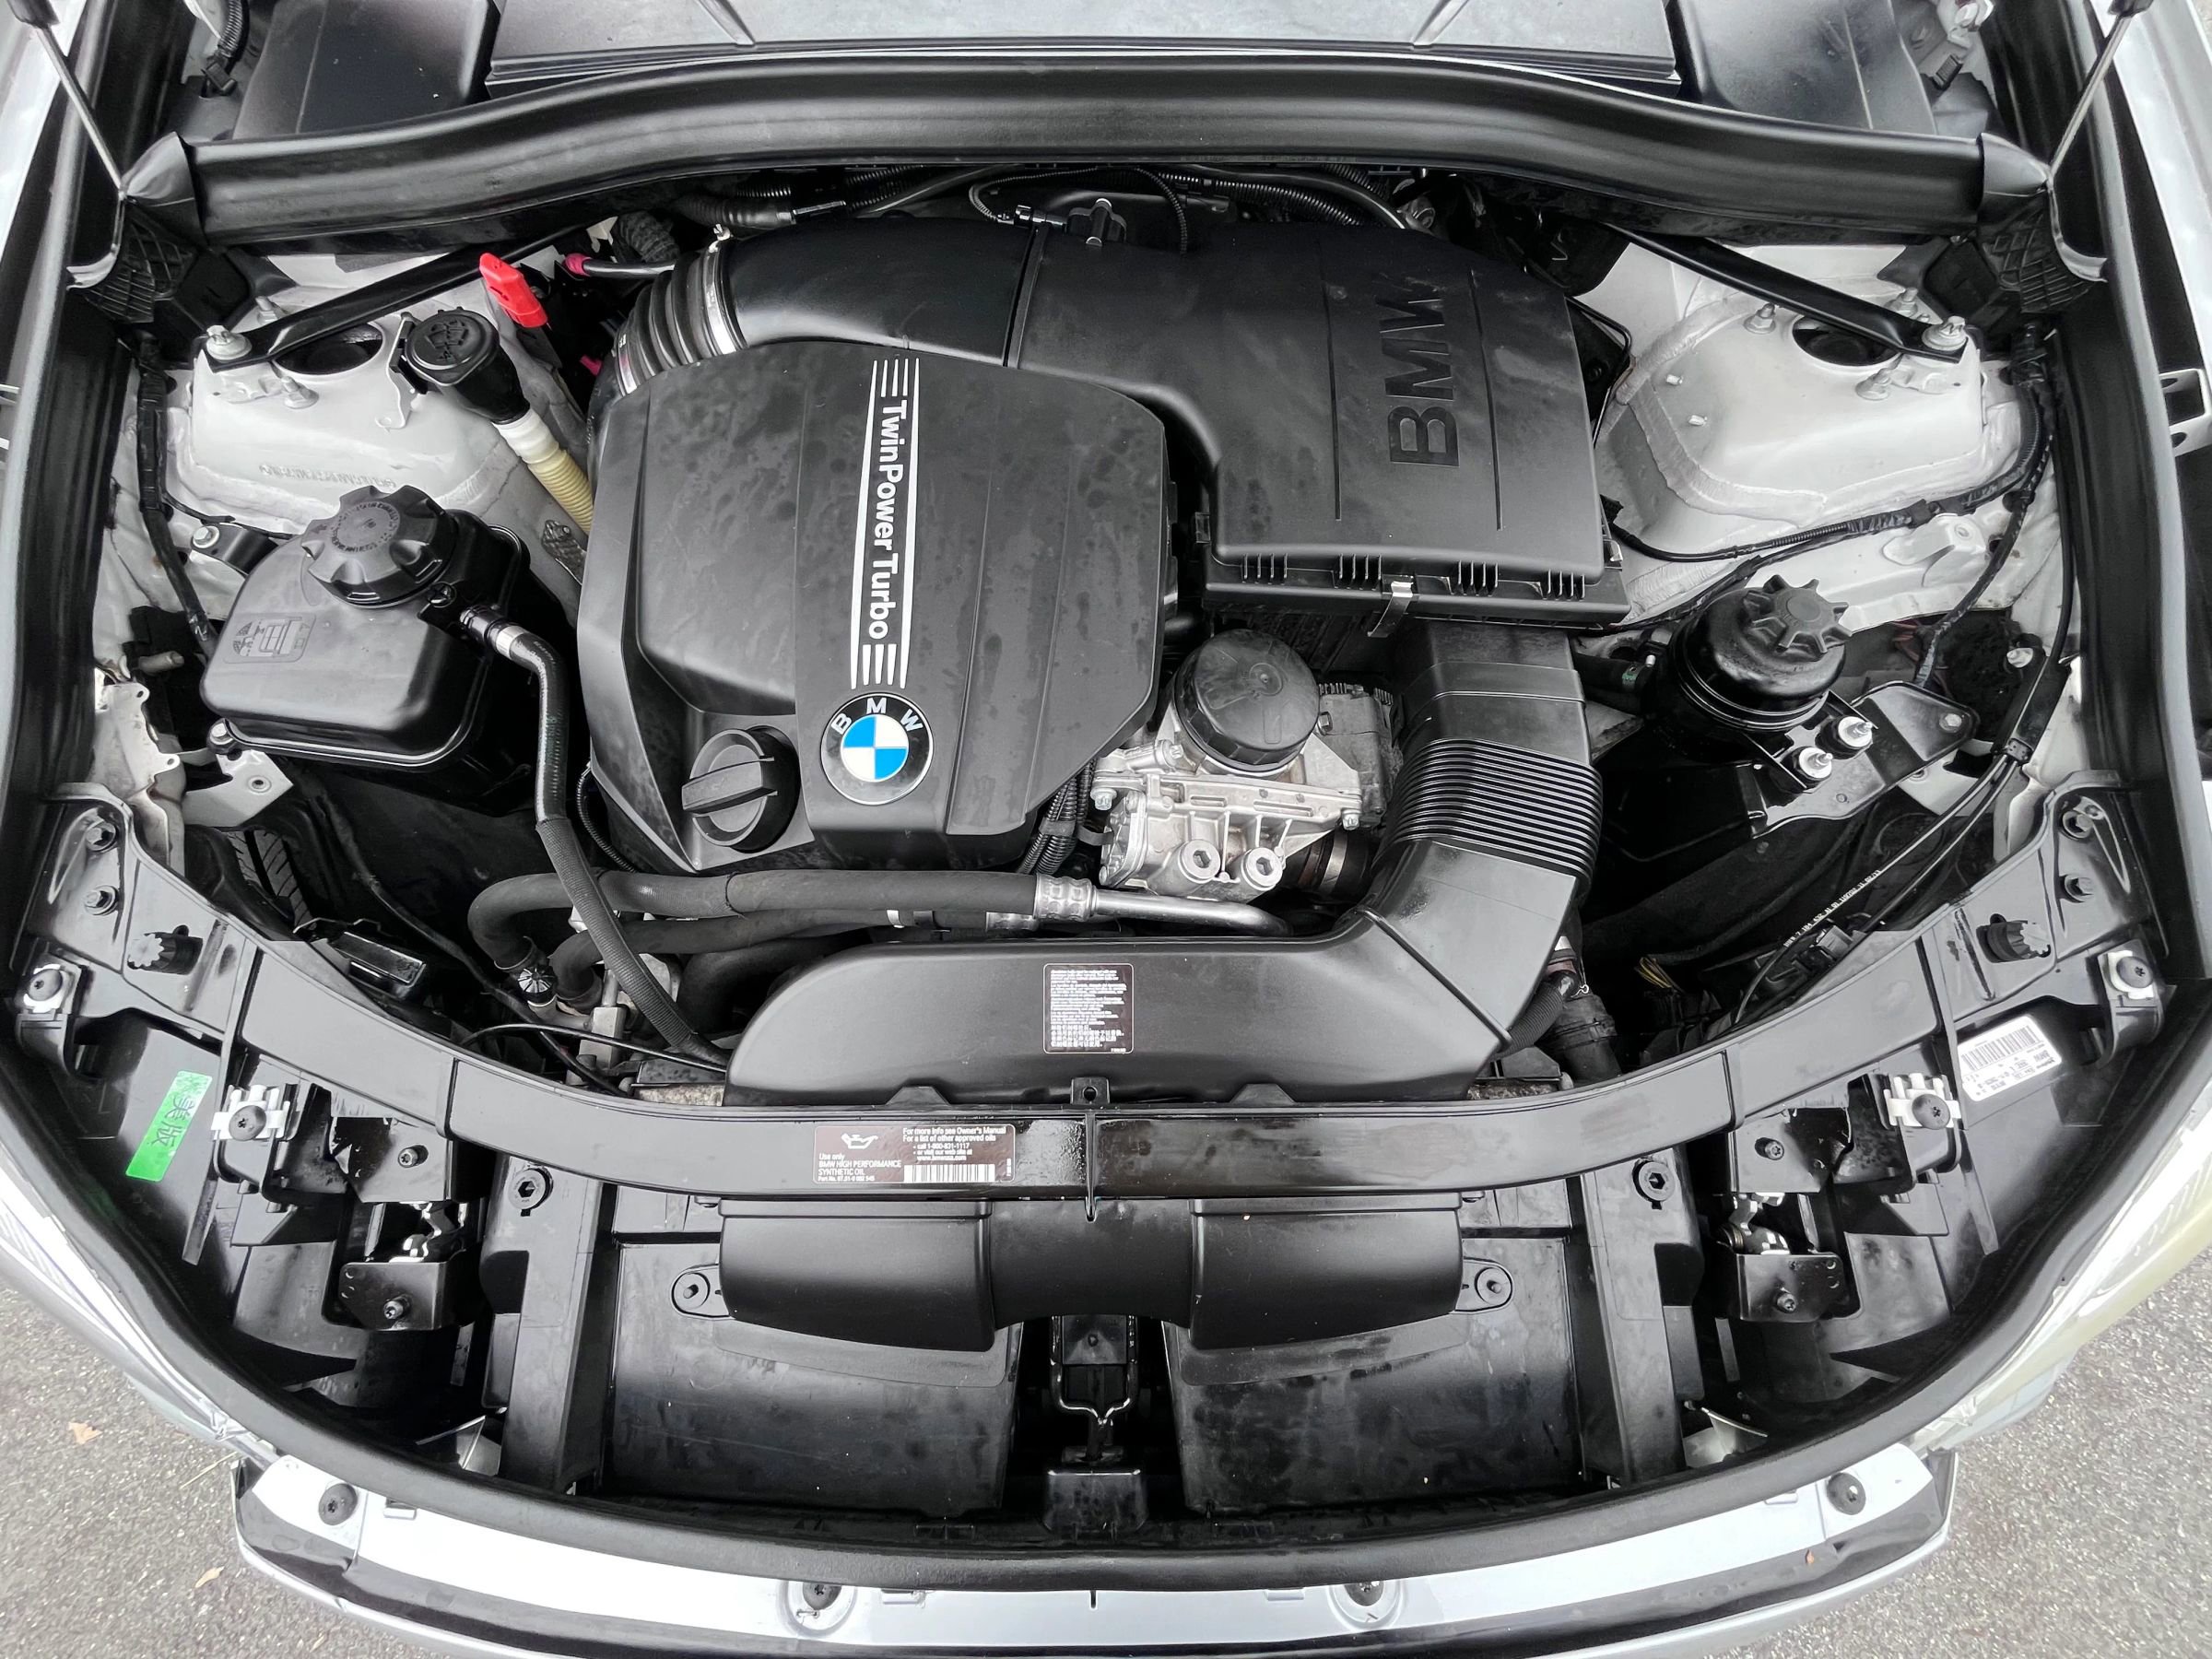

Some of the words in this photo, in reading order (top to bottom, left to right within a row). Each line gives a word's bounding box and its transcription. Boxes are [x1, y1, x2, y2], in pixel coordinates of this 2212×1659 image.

[1376, 273, 1460, 467] BMW
[874, 399, 908, 551] TwinPower
[868, 553, 899, 640] Turbo
[830, 697, 924, 735] BMW
[149, 1095, 195, 1147] 美版
[955, 1135, 983, 1143] approved
[957, 1126, 982, 1135] Owner's
[831, 1153, 845, 1161] only
